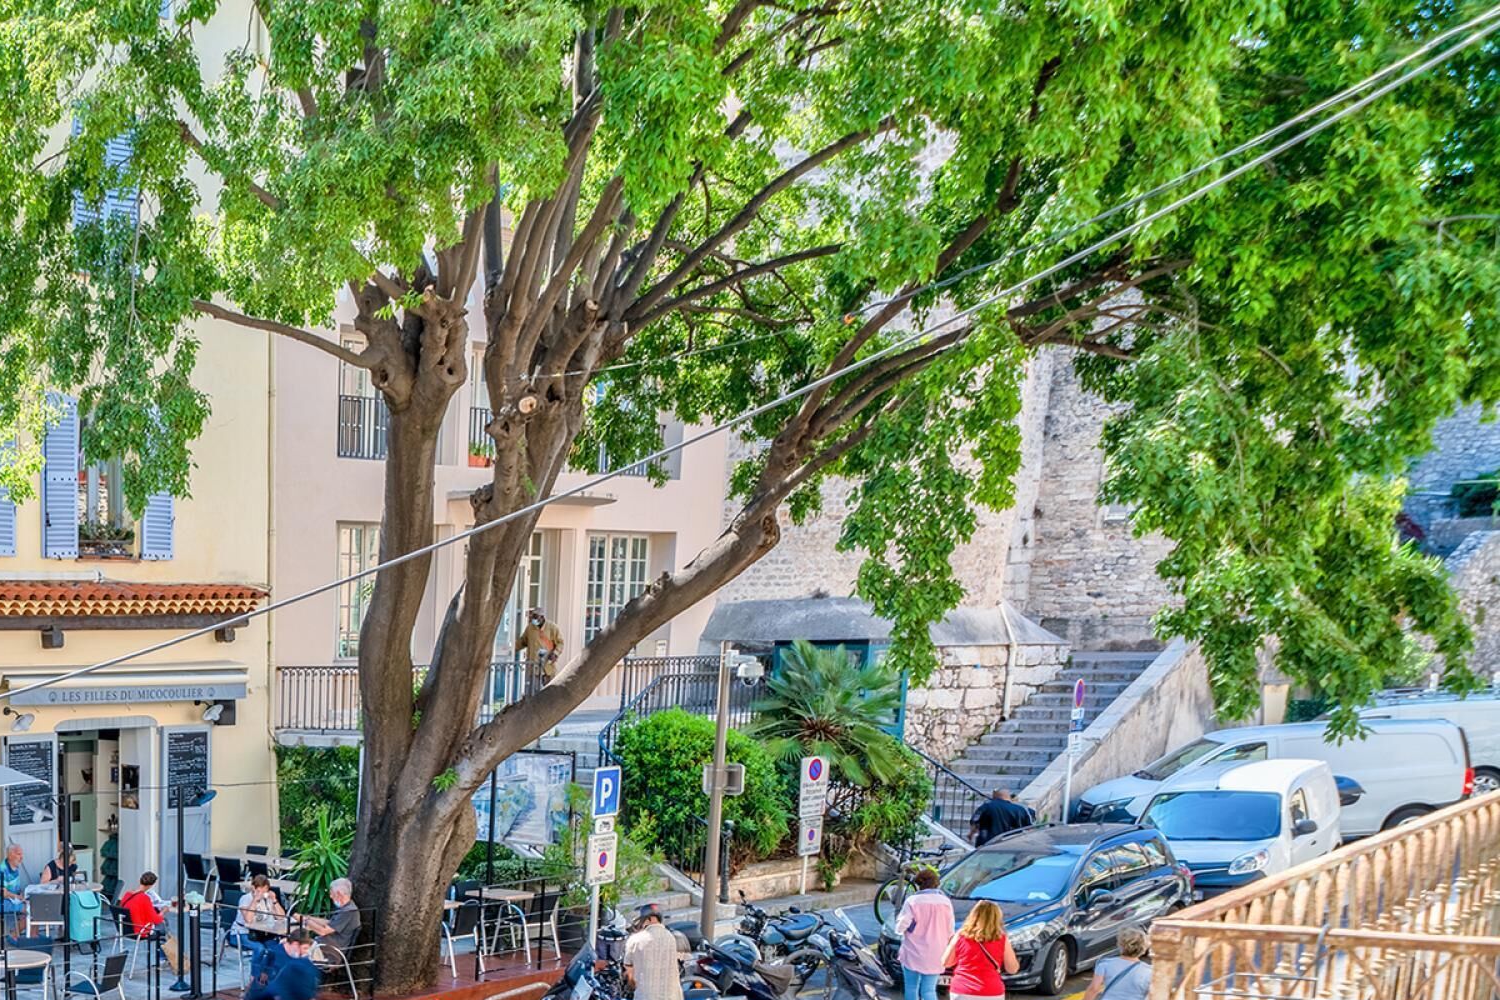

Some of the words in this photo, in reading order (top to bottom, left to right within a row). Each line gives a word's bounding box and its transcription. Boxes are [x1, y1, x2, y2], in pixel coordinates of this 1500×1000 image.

[62, 691, 81, 702] LES
[84, 690, 118, 701] FILLES
[120, 690, 133, 700] DU
[138, 688, 203, 700] MICOCOULIER
[599, 777, 613, 808] P
